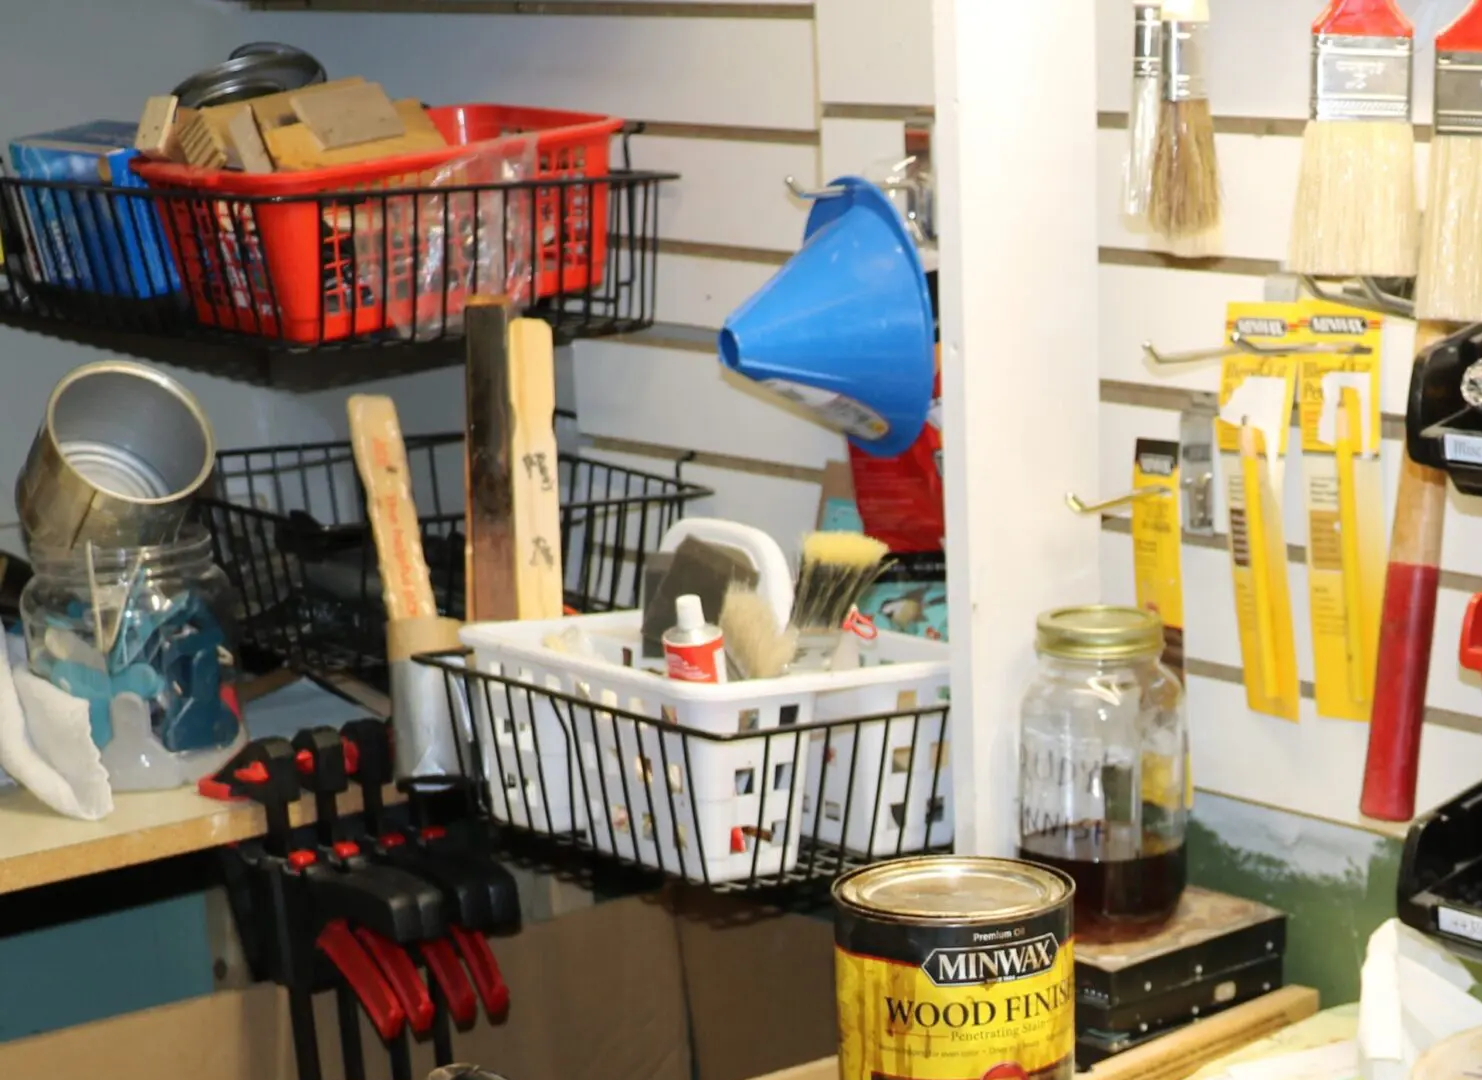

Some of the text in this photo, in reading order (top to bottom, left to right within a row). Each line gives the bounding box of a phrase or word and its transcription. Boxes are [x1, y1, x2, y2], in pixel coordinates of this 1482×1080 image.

[973, 928, 1025, 942] Premium Oil
[938, 939, 1051, 980] MINWAX
[885, 979, 1073, 1028] WOOD FINIS
[951, 1020, 1046, 1042] Penetrating Stain
